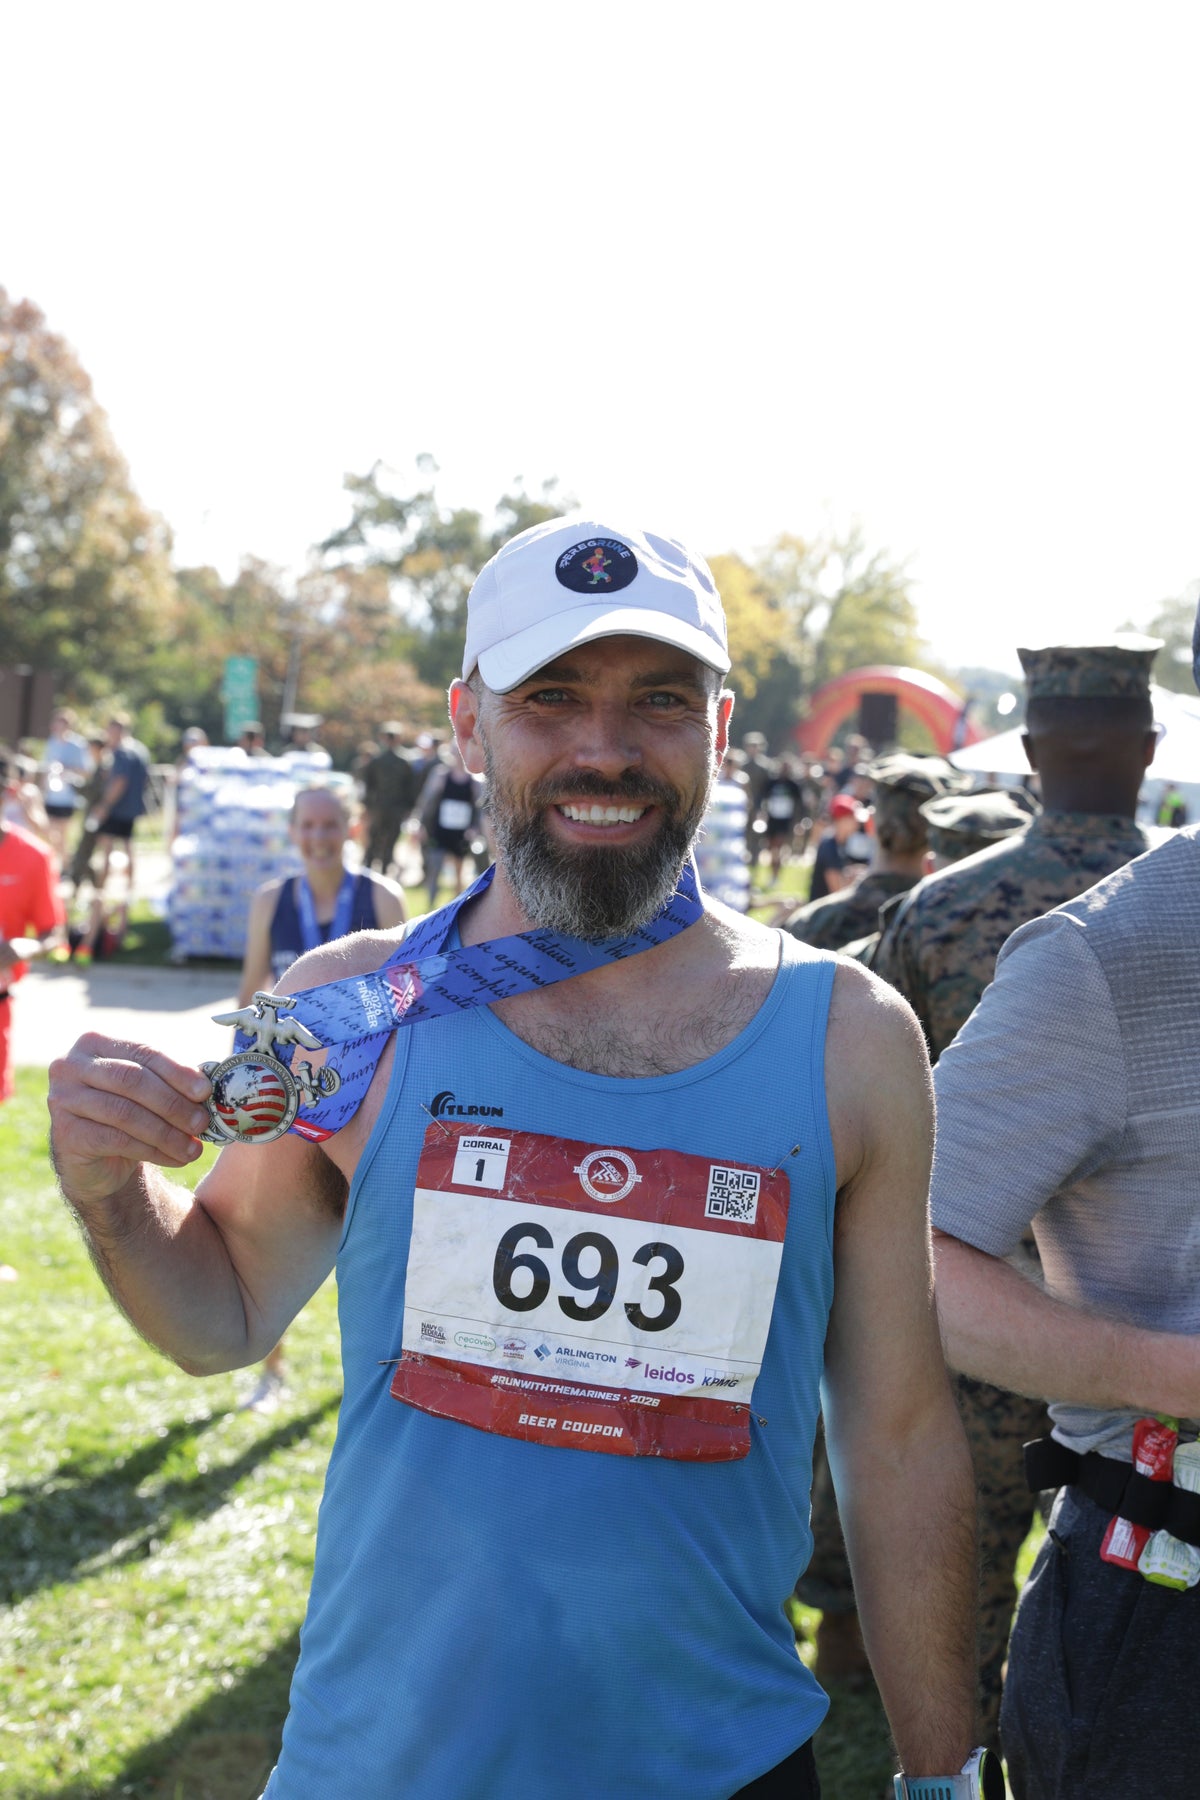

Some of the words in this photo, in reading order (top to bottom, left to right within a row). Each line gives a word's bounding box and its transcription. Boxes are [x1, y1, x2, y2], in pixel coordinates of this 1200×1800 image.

[356, 980, 378, 1029] FINISHER
[368, 988, 384, 1016] 2026
[462, 1140, 505, 1151] CORRAL
[475, 1158, 485, 1182] 1
[492, 1221, 685, 1333] 693
[421, 1322, 437, 1331] NAVY
[421, 1328, 445, 1339] FEDERAL
[554, 1357, 590, 1369] VIRGINIA
[556, 1347, 617, 1363] ARLINGTON
[644, 1363, 695, 1384] leidos
[701, 1376, 739, 1388] KPMG
[490, 1374, 621, 1402] #RUNWITHTHEMARINES
[518, 1413, 557, 1429] BEER
[561, 1420, 624, 1438] COUPON
